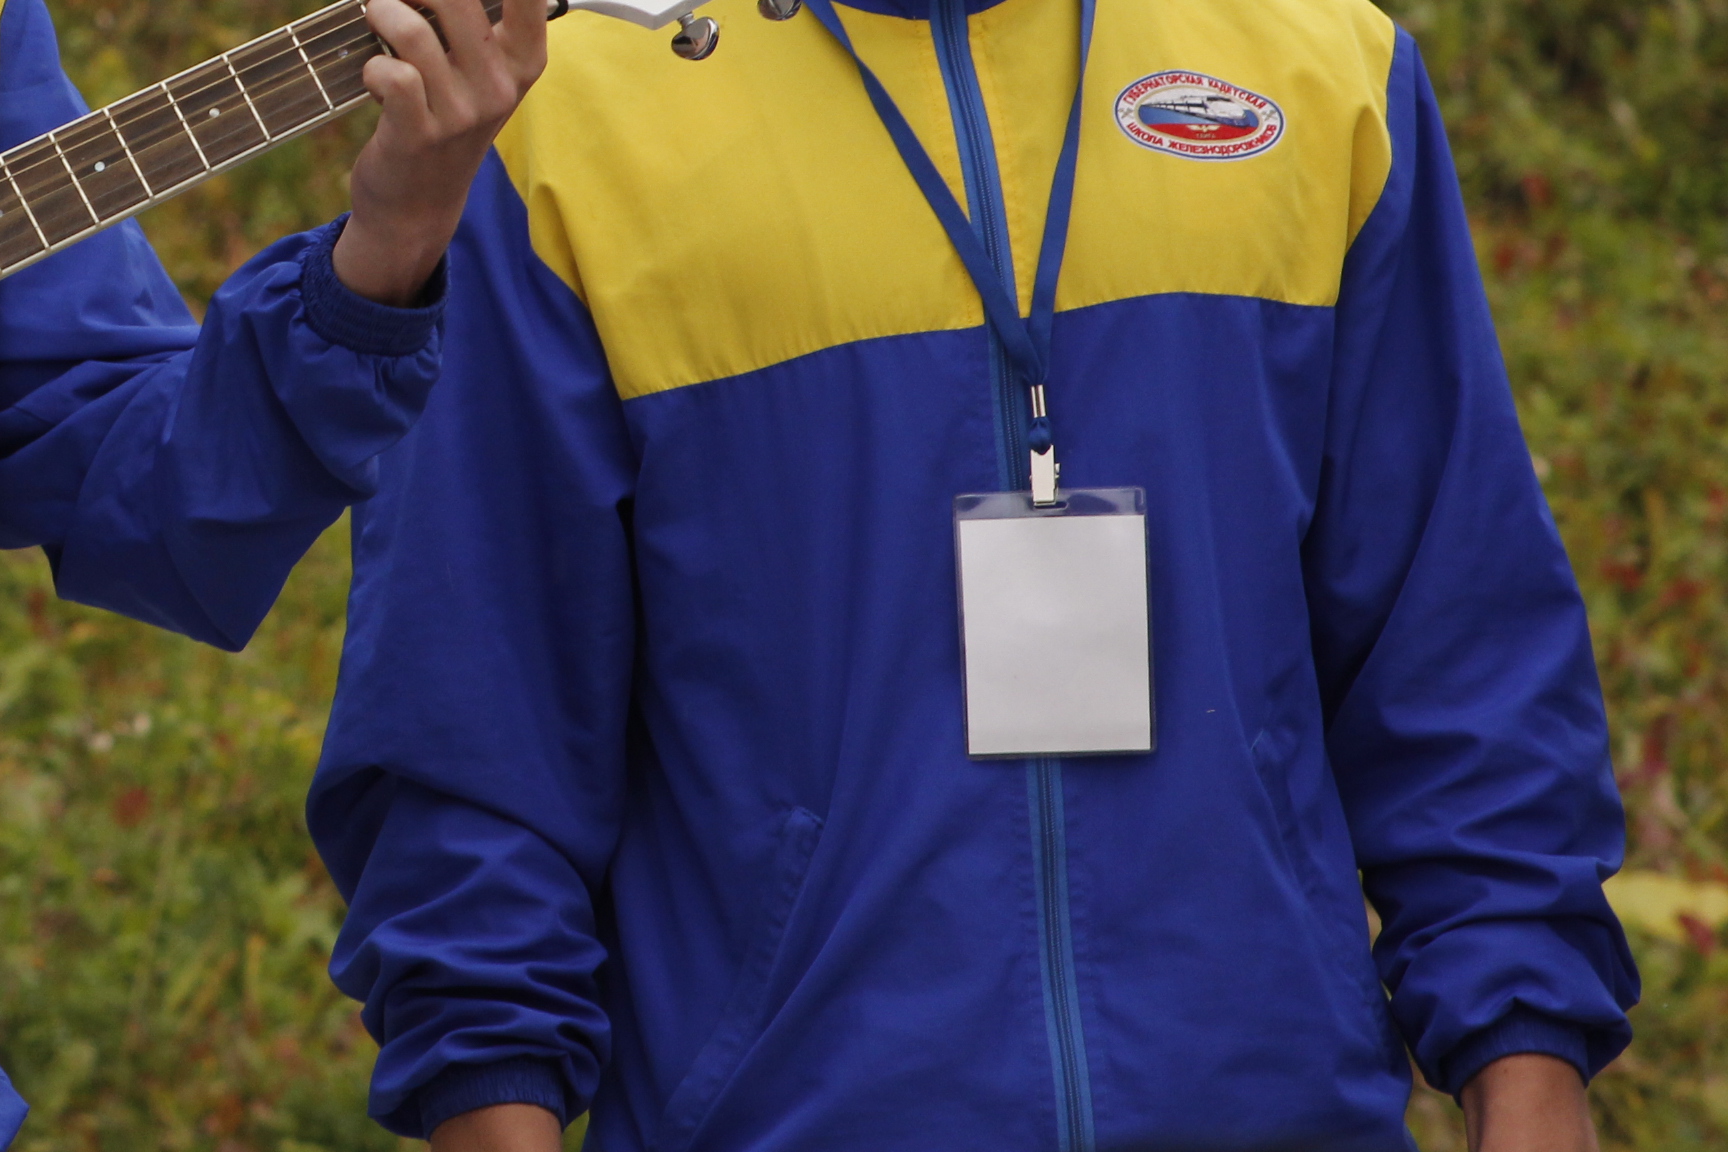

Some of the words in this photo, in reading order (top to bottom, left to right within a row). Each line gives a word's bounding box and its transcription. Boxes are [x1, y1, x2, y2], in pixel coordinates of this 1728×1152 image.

[1123, 73, 1203, 105] ГУБЕРНАТОРСКАЯ
[1208, 77, 1267, 110] КАДЕТСКАЯ
[1126, 122, 1163, 146] ШКОЛА
